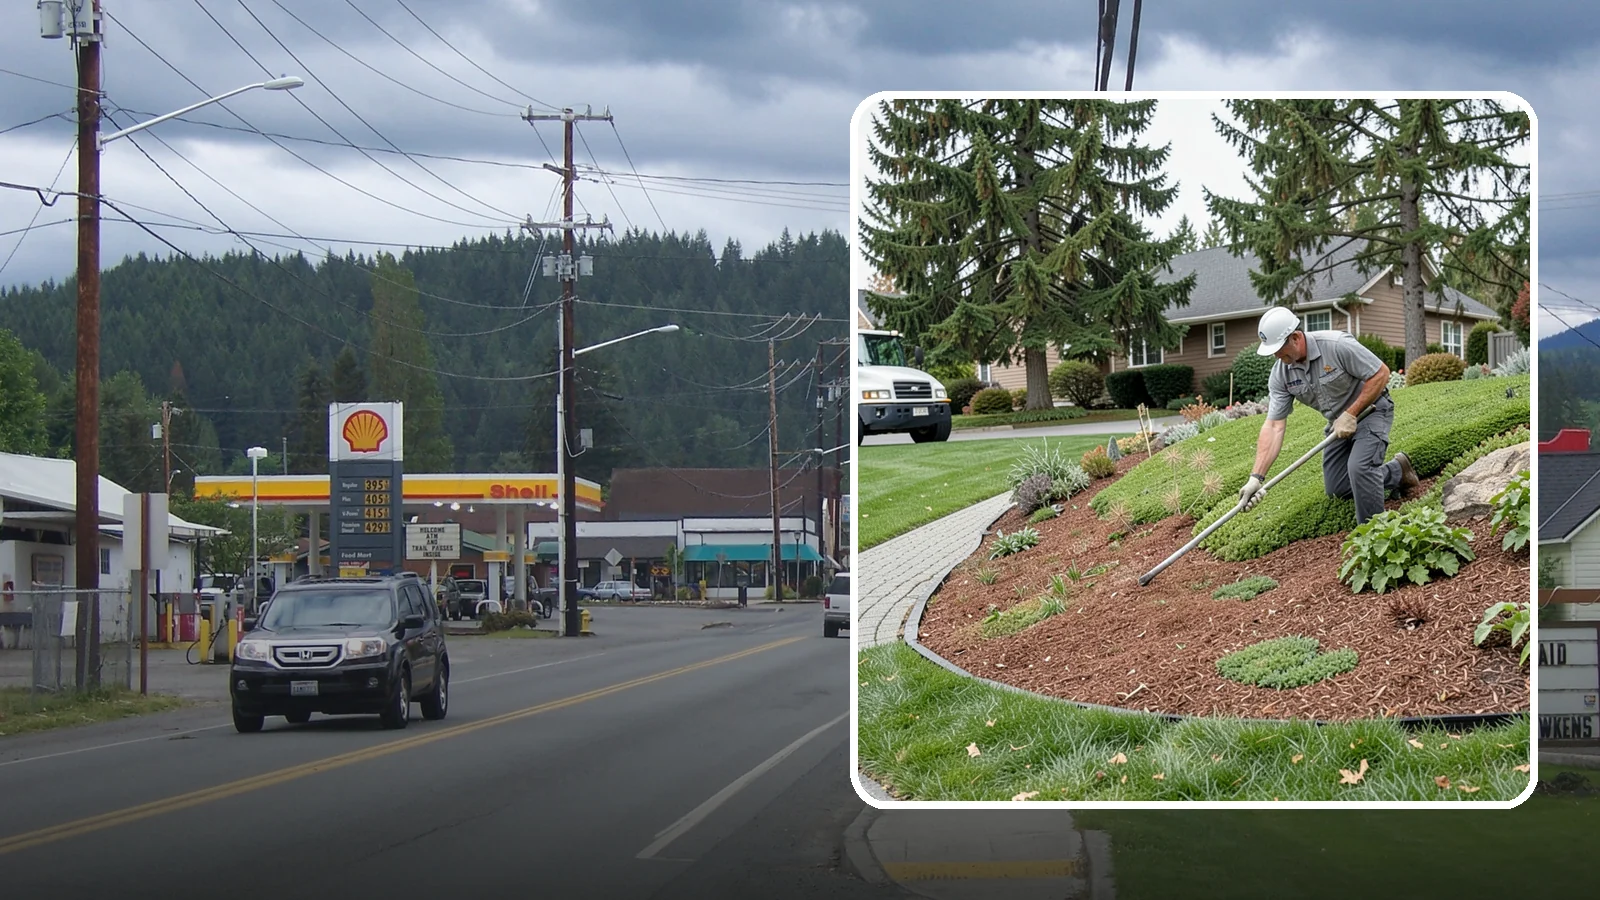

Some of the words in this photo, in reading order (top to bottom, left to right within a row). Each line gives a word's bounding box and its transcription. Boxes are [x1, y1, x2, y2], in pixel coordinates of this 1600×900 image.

[366, 480, 383, 490] 395
[490, 484, 547, 499] Shell
[366, 494, 383, 504] 405
[366, 508, 383, 518] 415
[366, 522, 383, 532] 429
